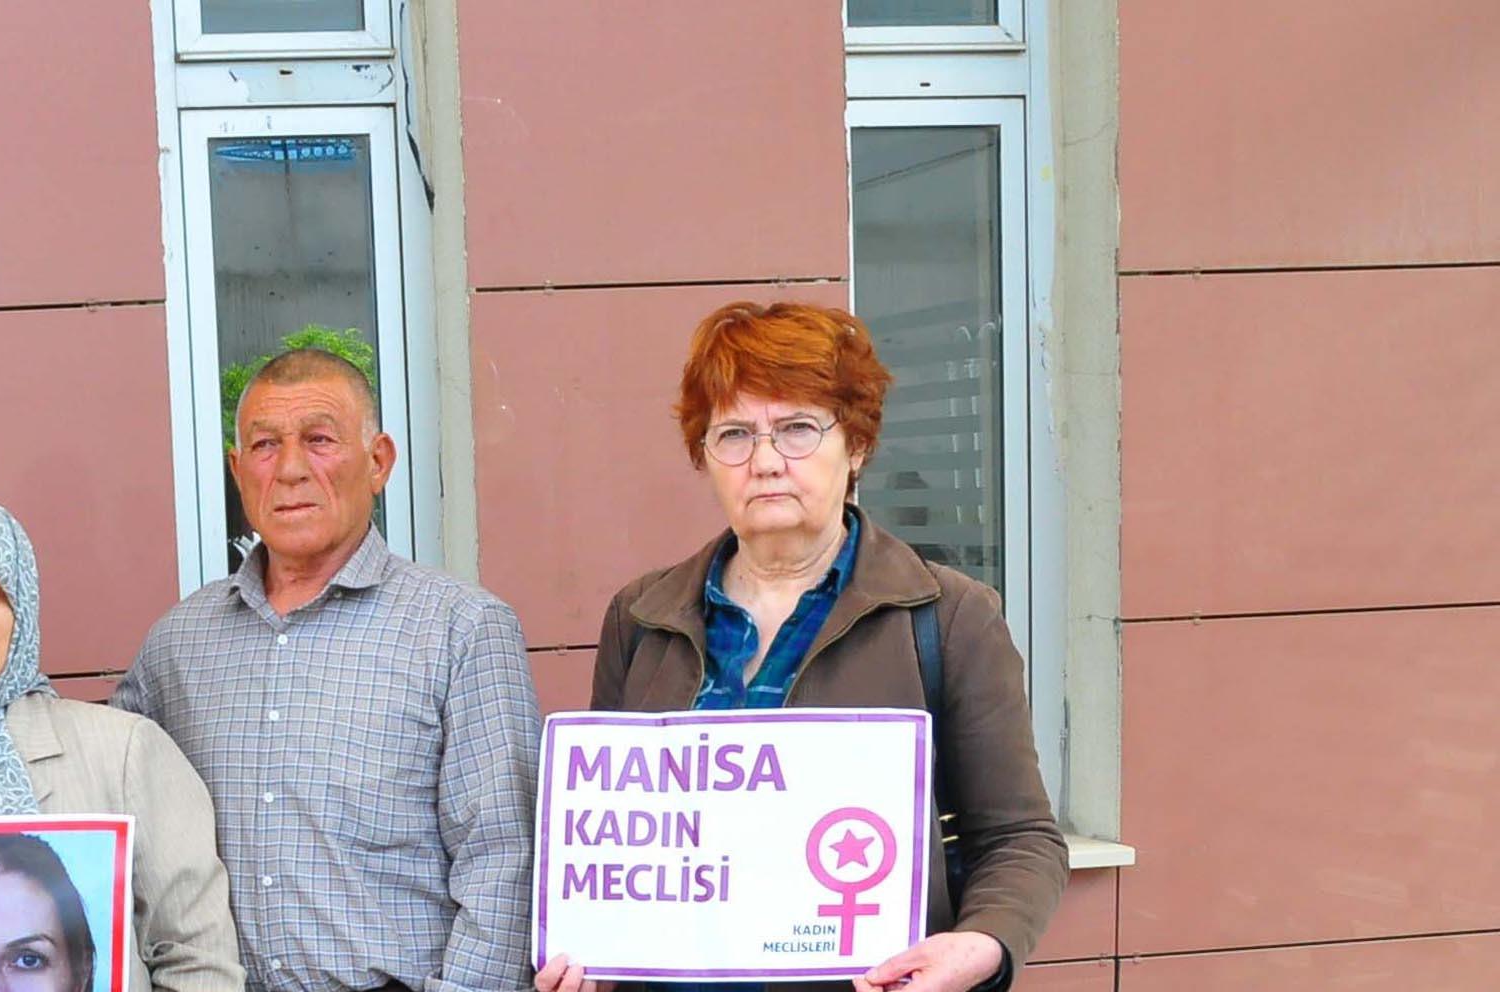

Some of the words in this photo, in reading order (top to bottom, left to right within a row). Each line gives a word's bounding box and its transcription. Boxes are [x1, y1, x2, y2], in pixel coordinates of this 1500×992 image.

[566, 733, 787, 793] MANİSA
[564, 808, 701, 848] KADIN
[561, 855, 730, 903] MECLİSİ
[793, 924, 837, 936] KADIN
